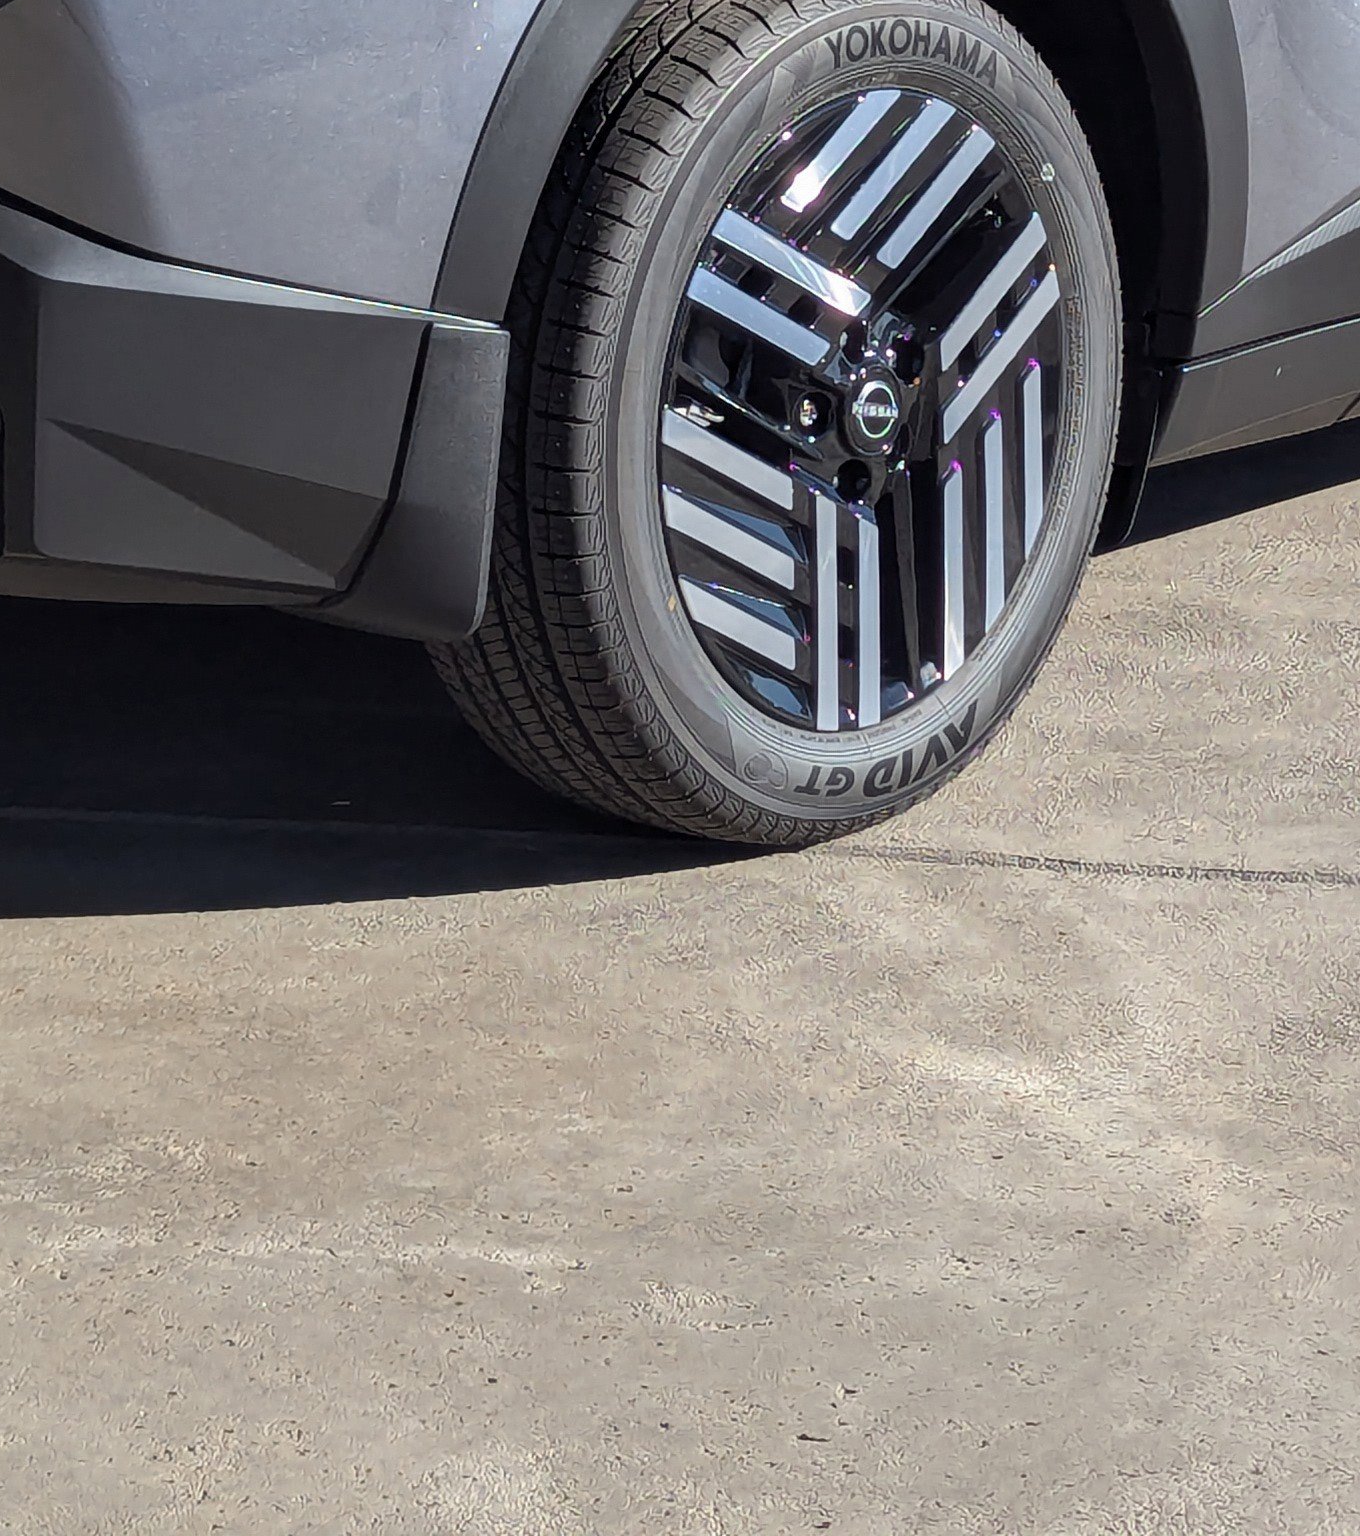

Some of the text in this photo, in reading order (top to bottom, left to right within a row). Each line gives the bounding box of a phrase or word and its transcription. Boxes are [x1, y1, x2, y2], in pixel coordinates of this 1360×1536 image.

[824, 17, 999, 88] YOKOHAMA
[793, 764, 855, 797] GT
[862, 698, 978, 799] AVID
